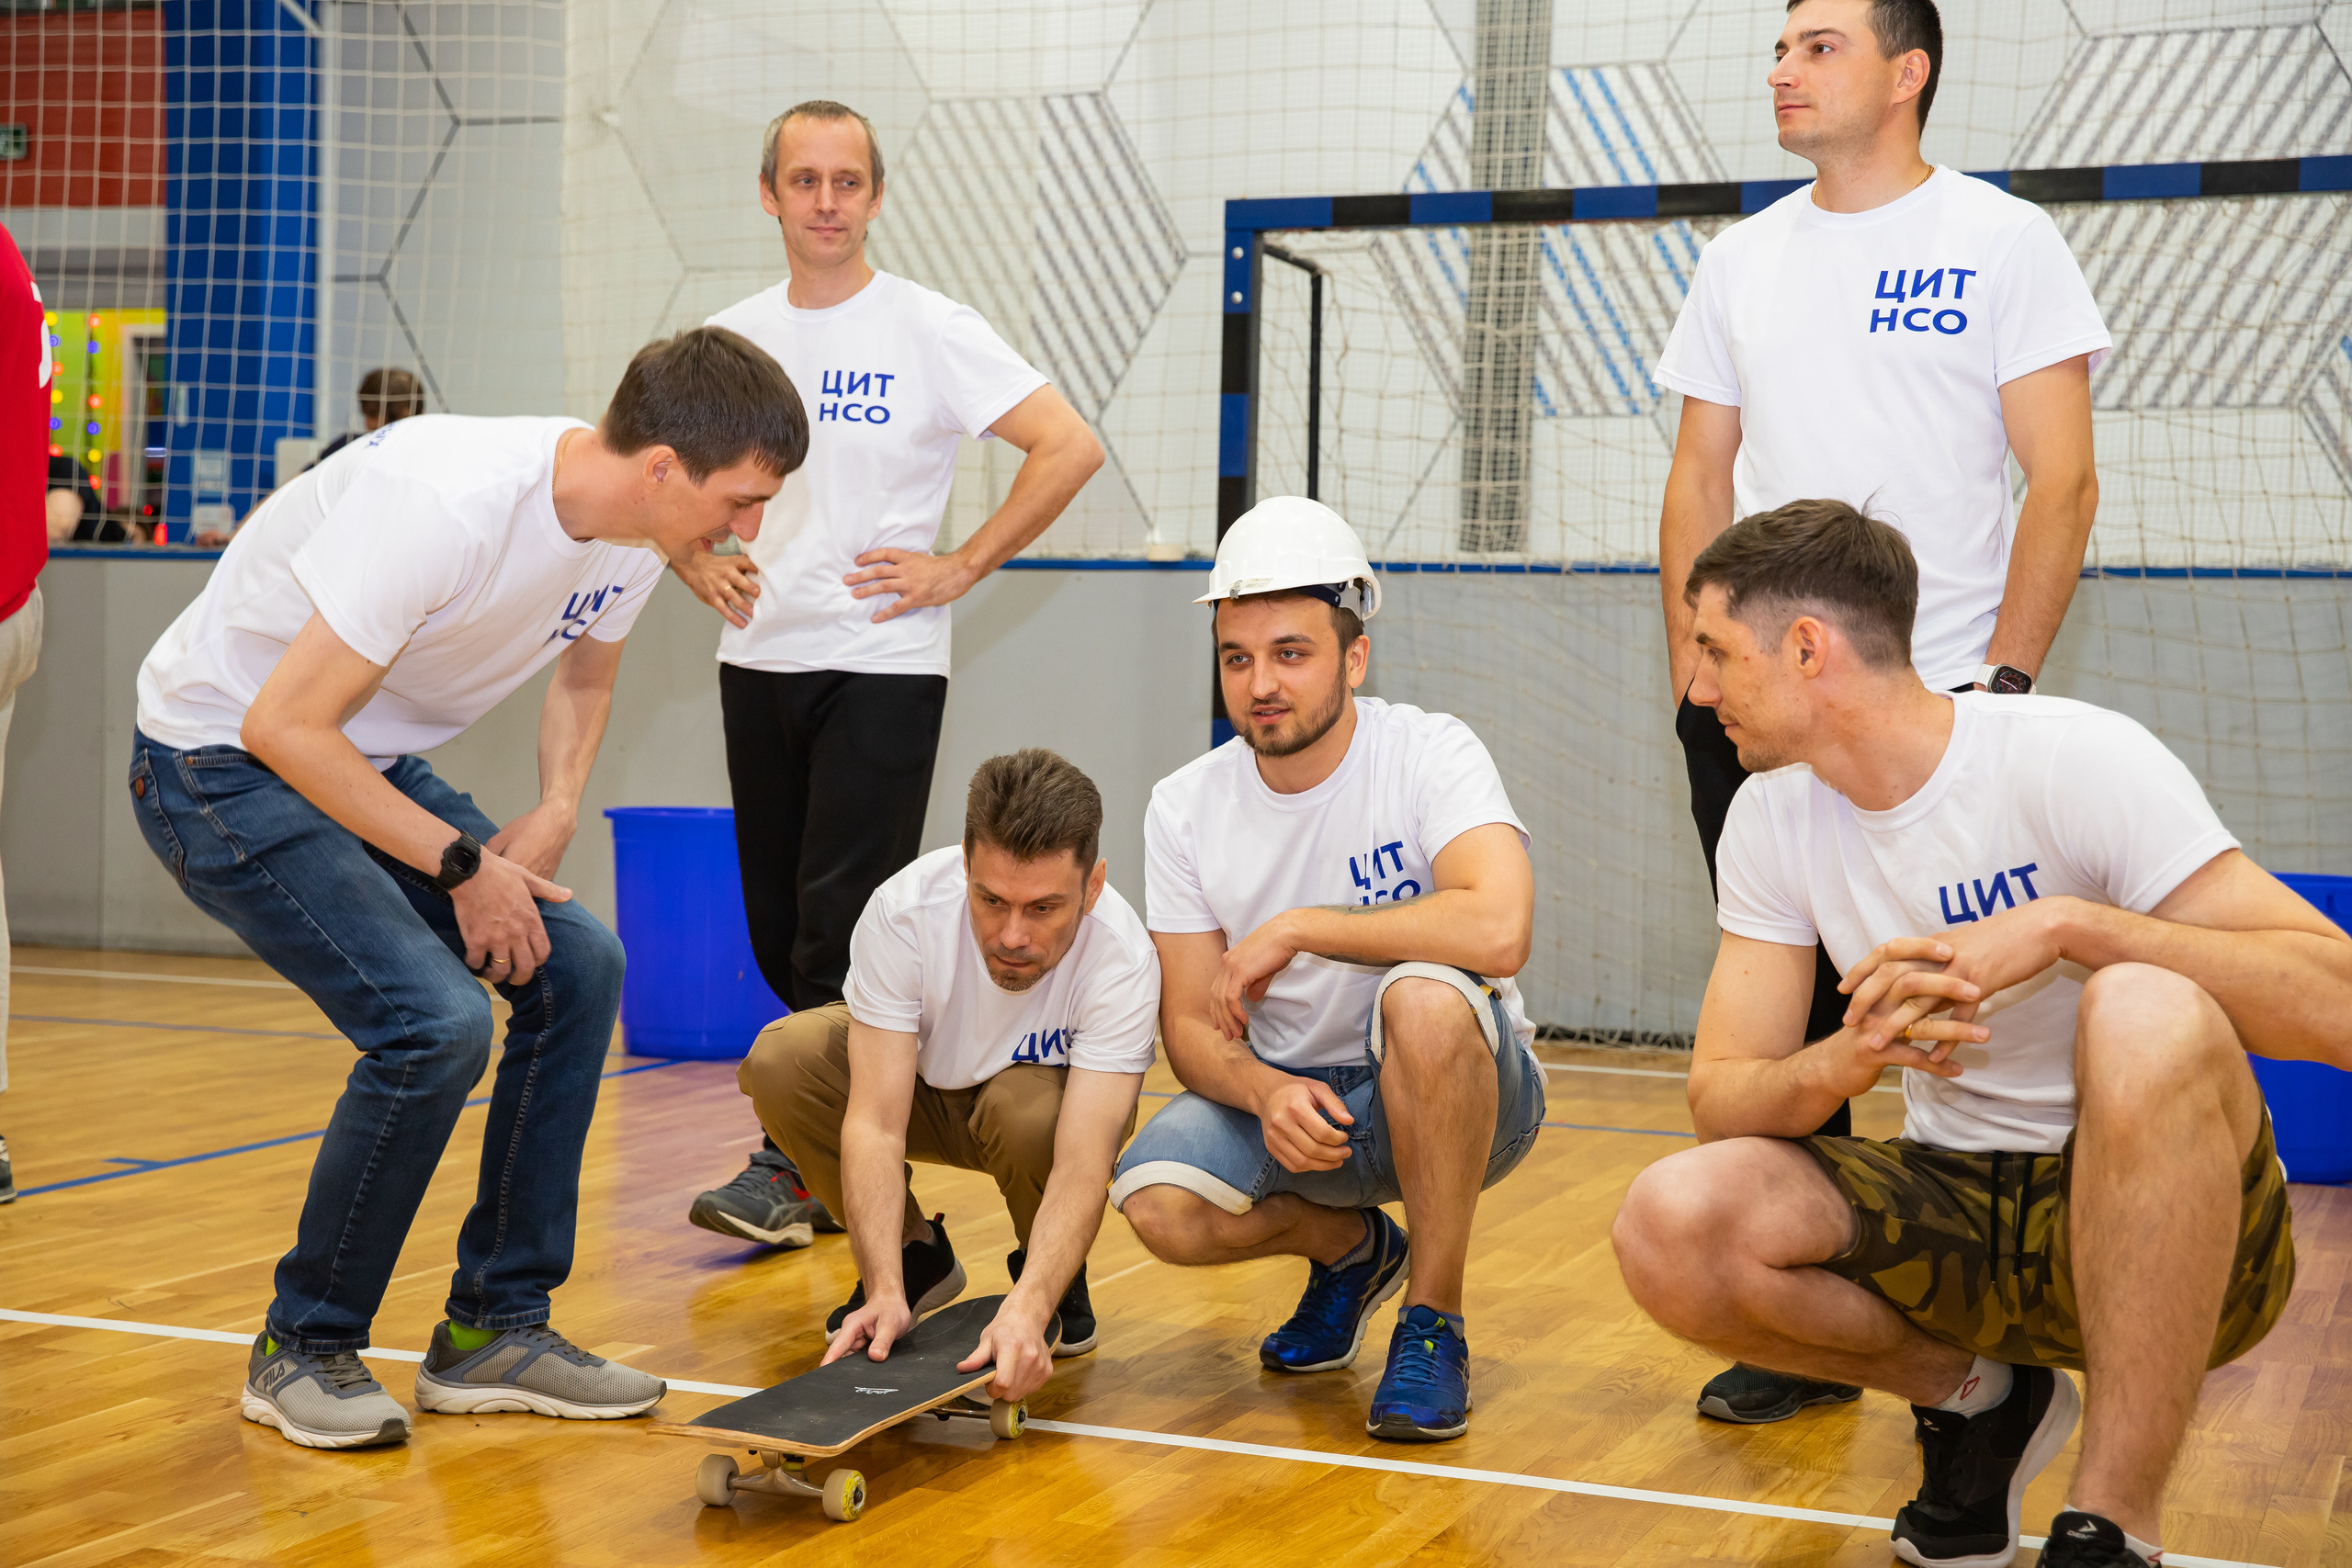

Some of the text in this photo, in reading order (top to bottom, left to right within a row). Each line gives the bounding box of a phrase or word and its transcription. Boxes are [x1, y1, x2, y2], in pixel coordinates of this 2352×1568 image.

[1874, 267, 1977, 303] ЦИТ
[1870, 308, 1968, 335] НСО
[821, 370, 895, 398] ЦИТ
[819, 402, 890, 424] НСО
[1939, 862, 2040, 925] ЦИТ
[263, 1361, 285, 1393] FILA
